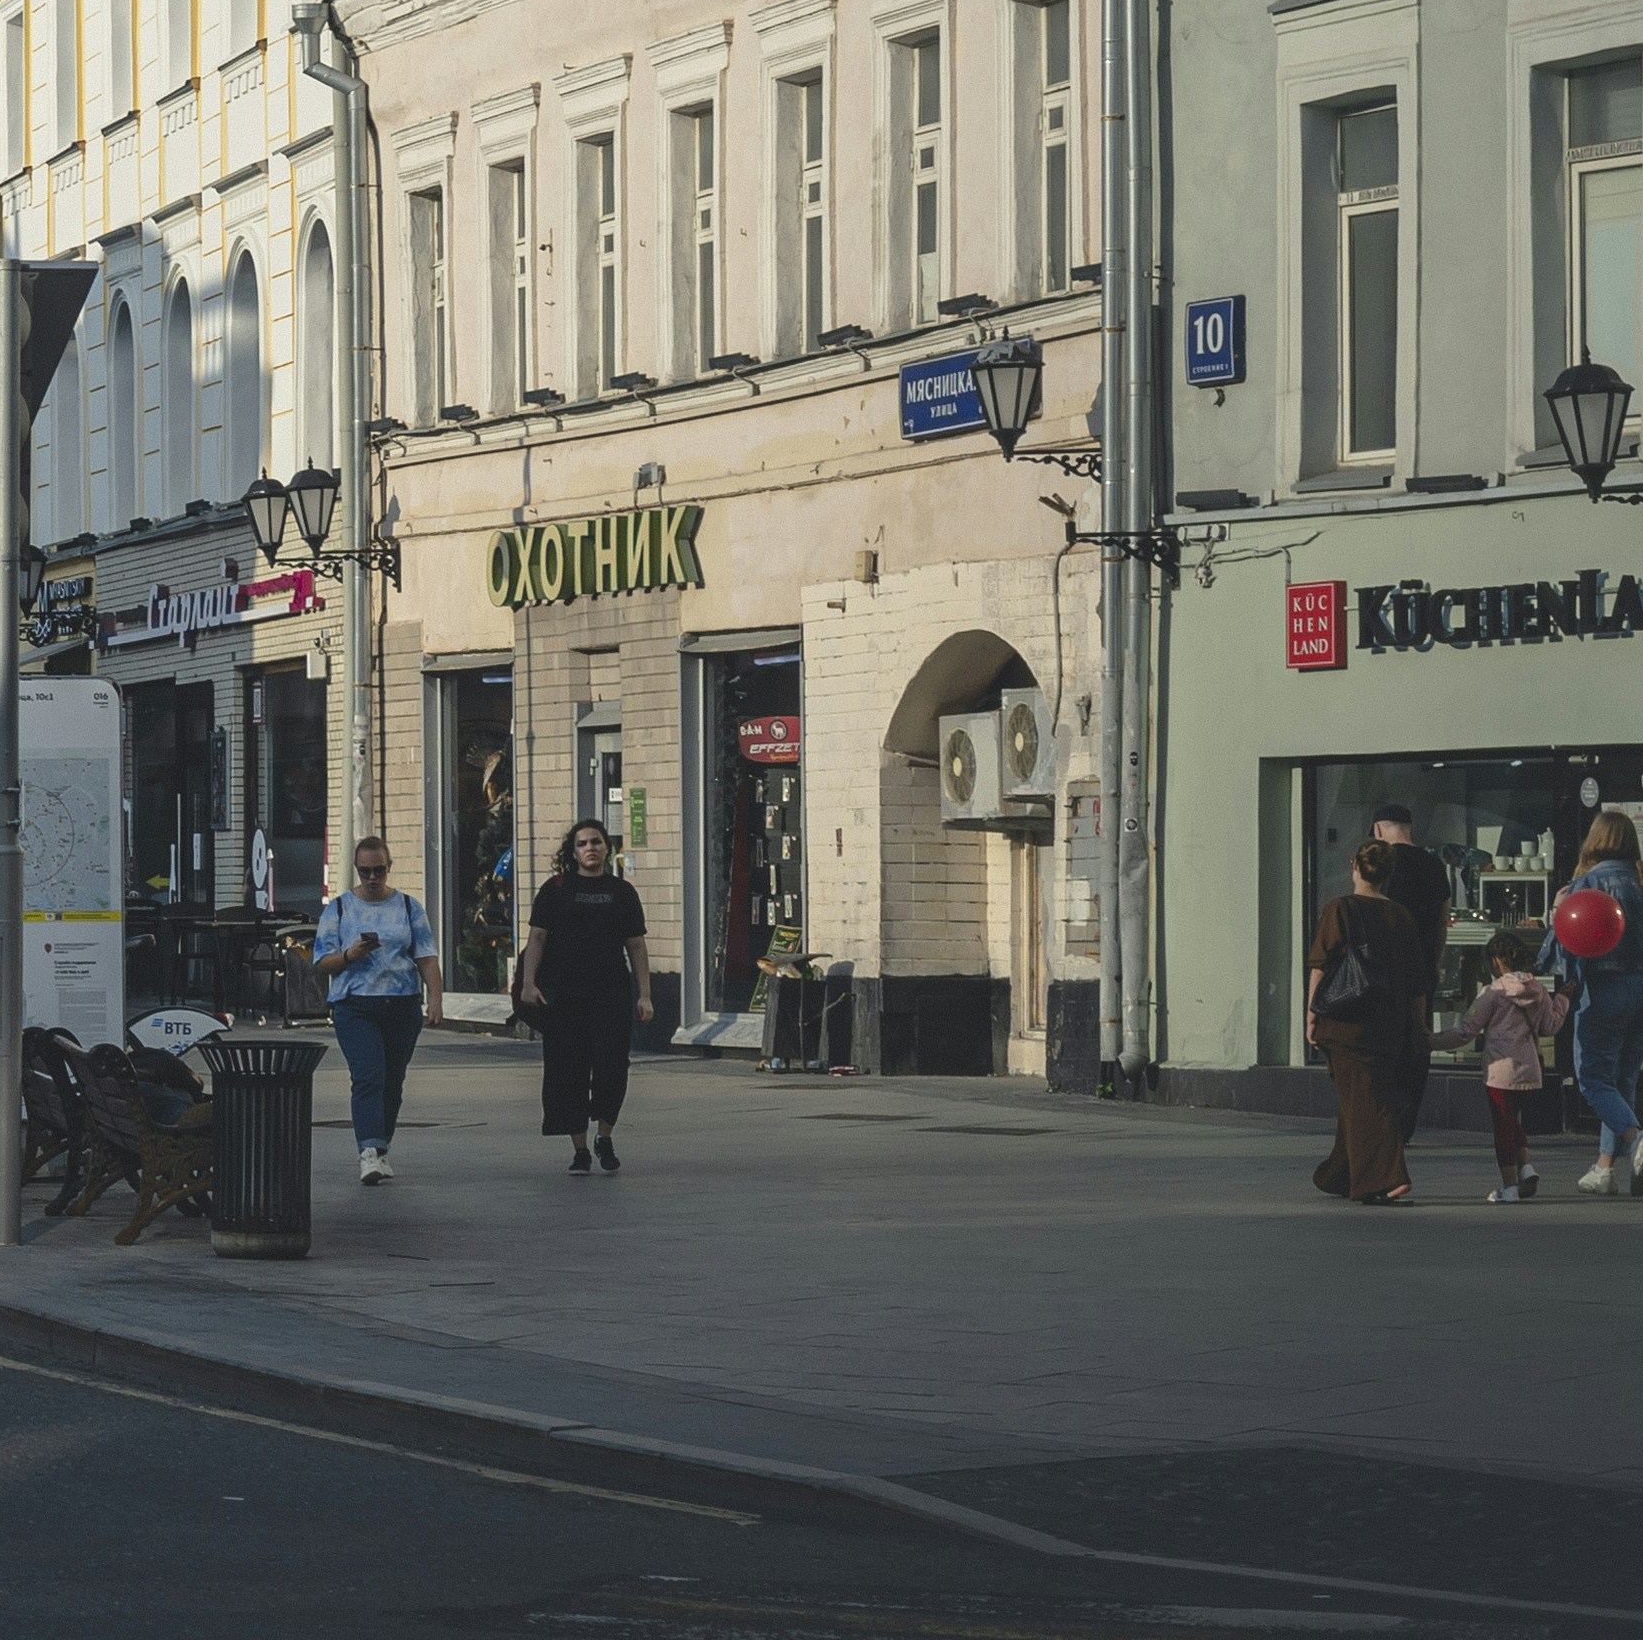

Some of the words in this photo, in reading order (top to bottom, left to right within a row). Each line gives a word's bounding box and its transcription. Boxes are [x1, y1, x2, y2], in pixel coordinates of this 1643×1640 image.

[1193, 312, 1224, 355] 10
[906, 368, 977, 405] МЯСНИЦКА
[929, 402, 958, 419] УЛИЦА
[487, 505, 695, 607] ОХОТНИК
[1293, 616, 1328, 633] HEN
[1293, 638, 1328, 655] LAND
[164, 1022, 192, 1035] ВТБ
